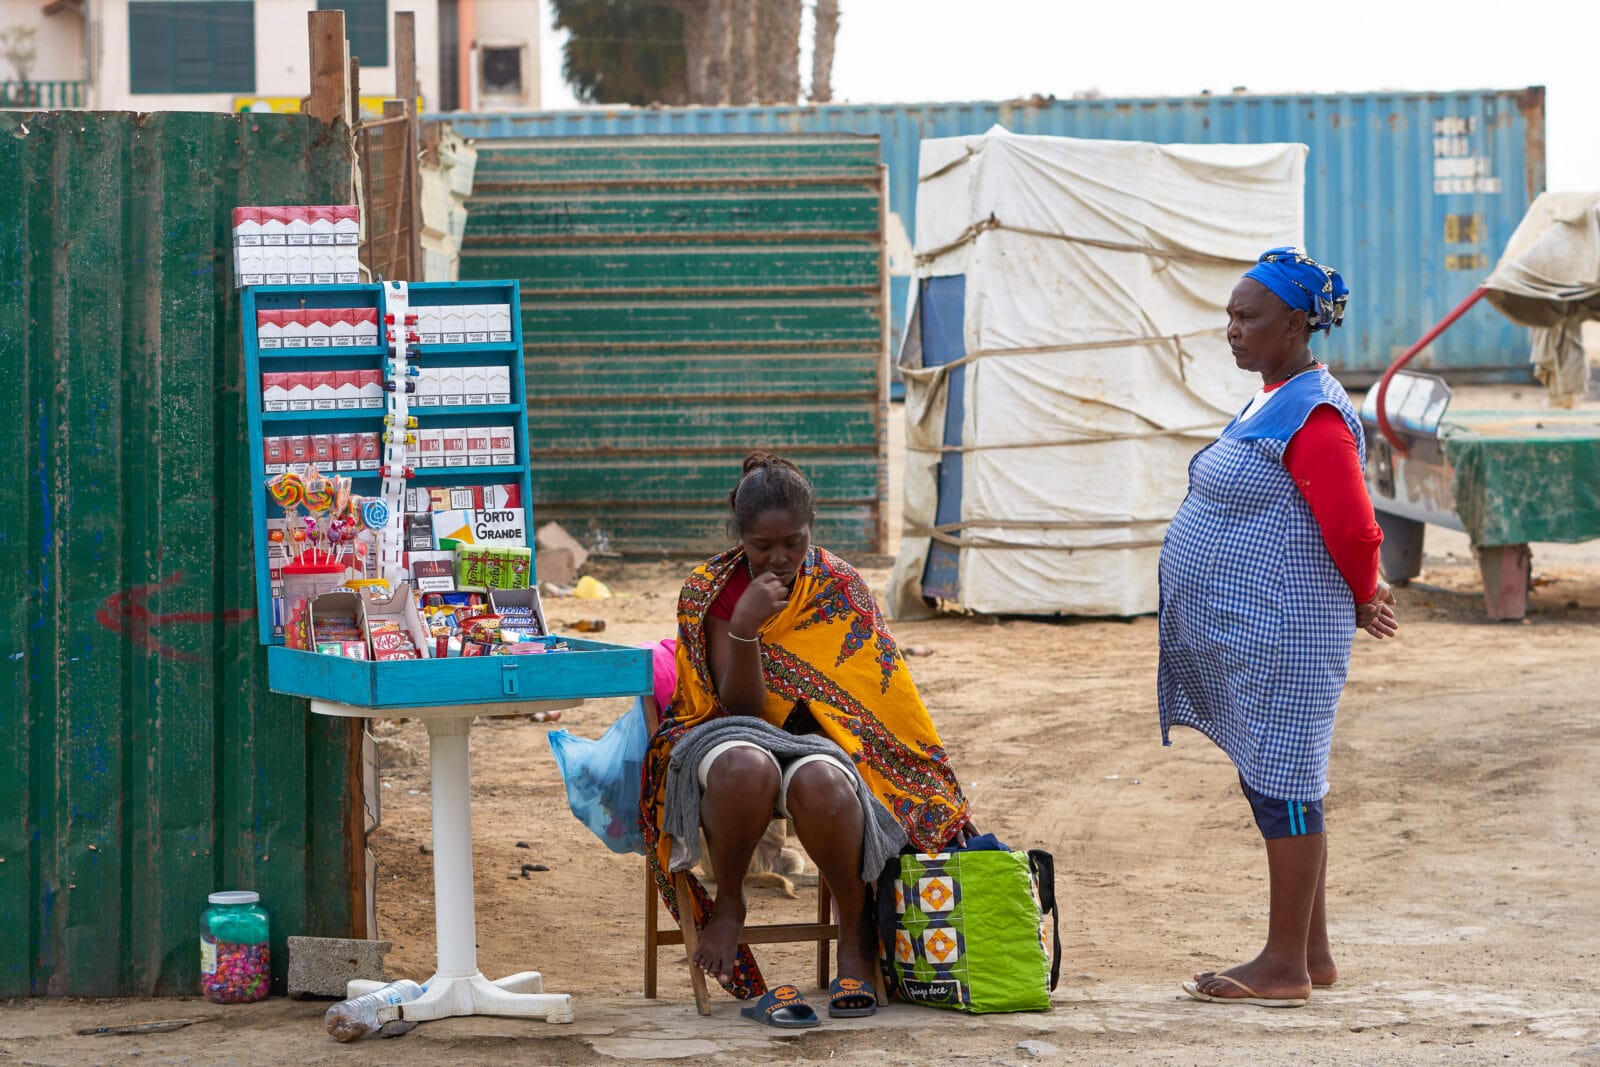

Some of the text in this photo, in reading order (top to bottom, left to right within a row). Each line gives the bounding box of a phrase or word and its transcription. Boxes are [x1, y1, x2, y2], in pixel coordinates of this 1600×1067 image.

[475, 508, 514, 523] PORTO
[476, 523, 522, 540] GRANDE
[909, 984, 948, 1000] pingo doce
